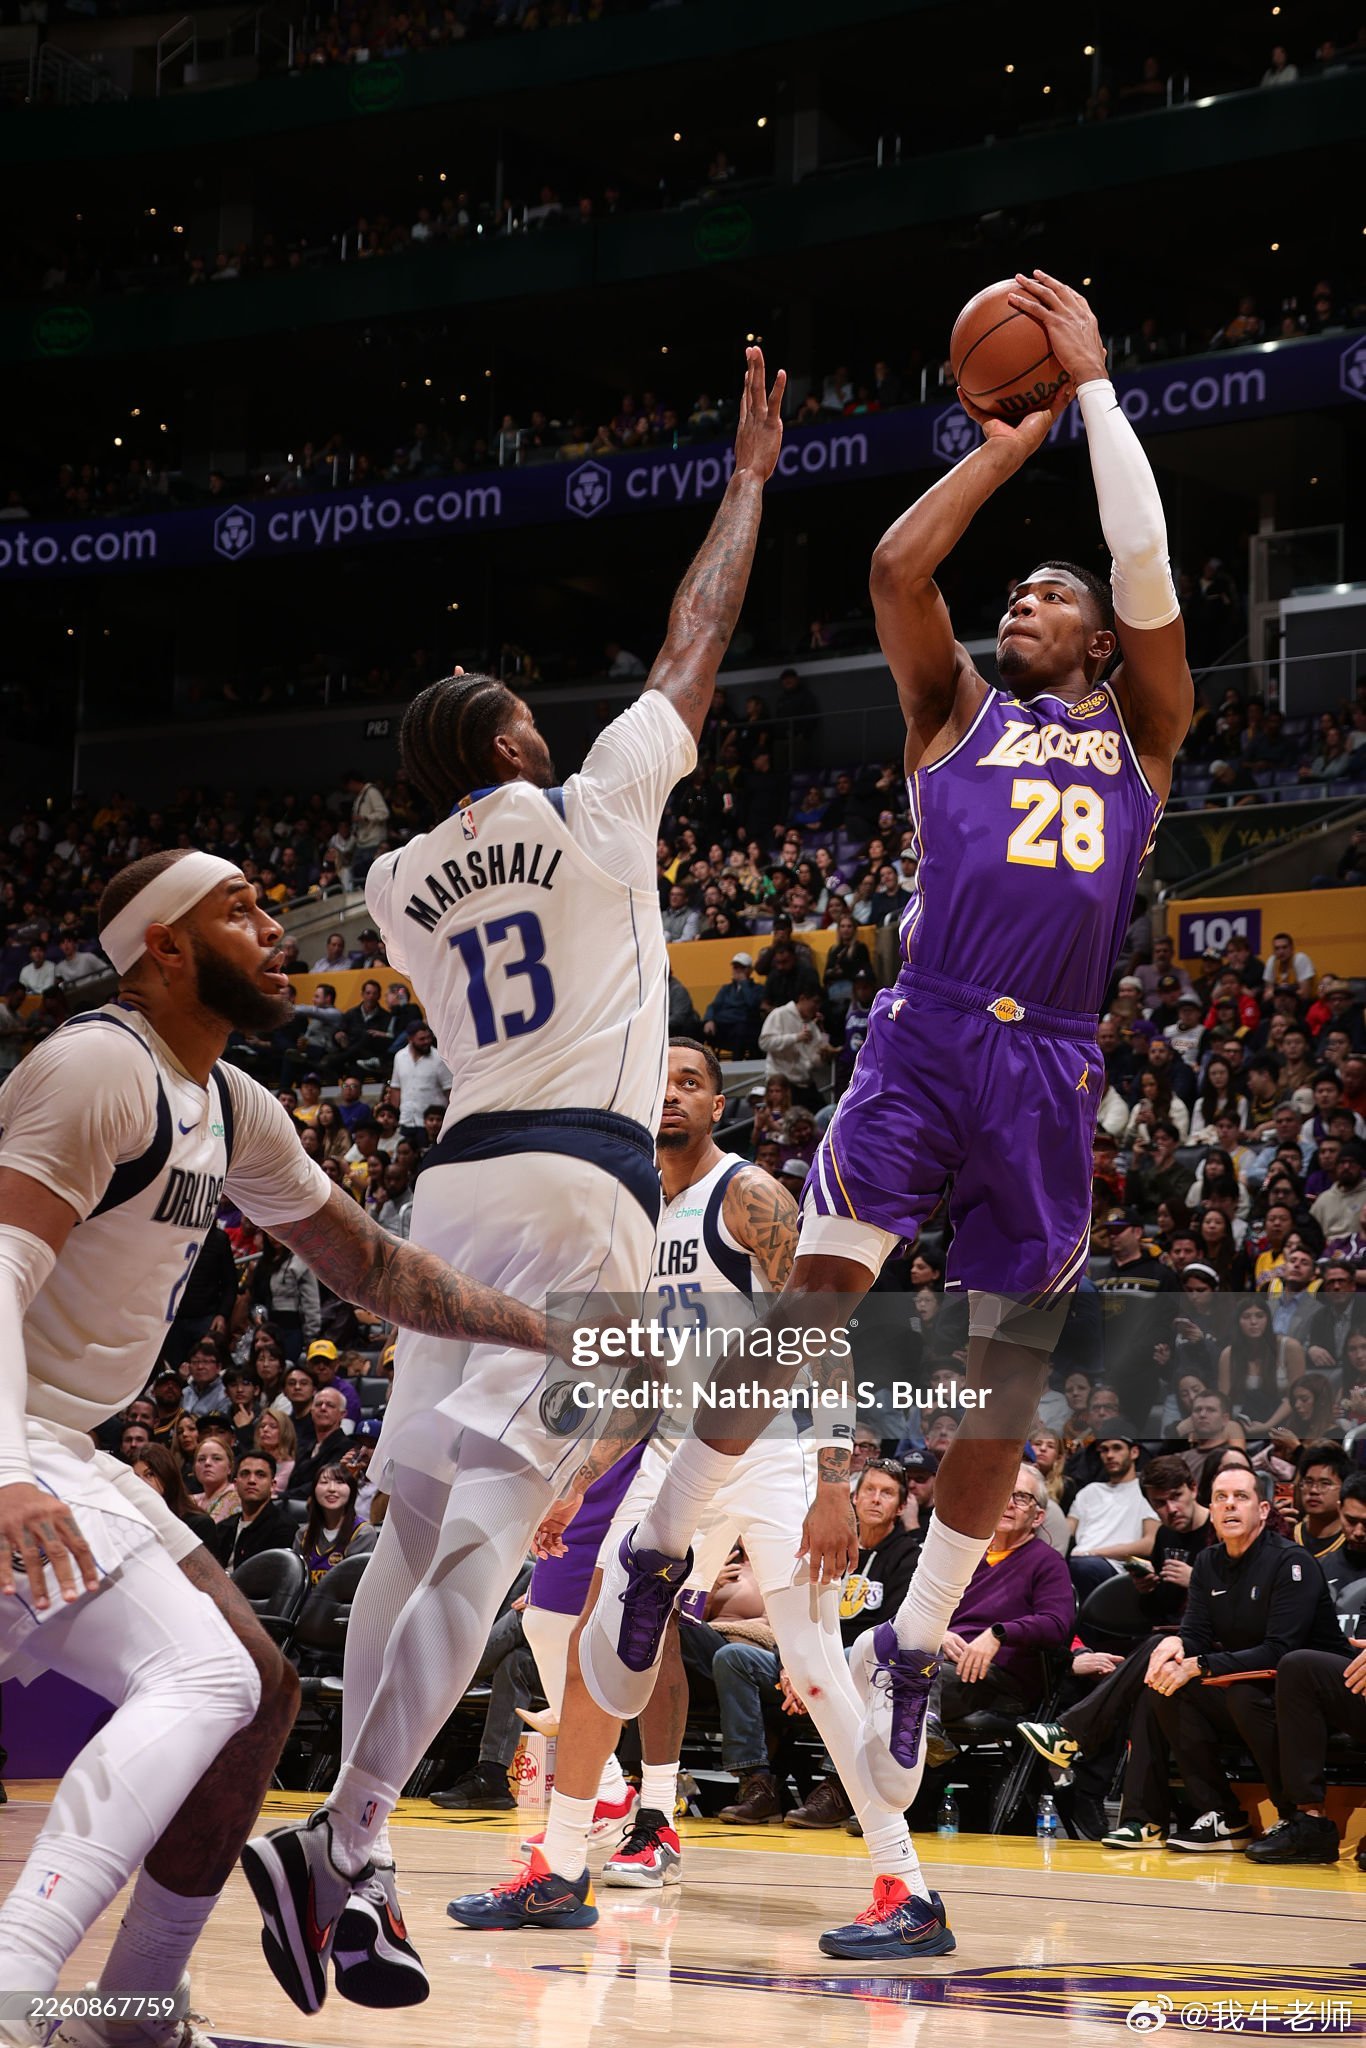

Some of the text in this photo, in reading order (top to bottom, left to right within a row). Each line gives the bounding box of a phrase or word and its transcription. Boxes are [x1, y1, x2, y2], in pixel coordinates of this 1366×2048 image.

[996, 370, 1072, 413] Wilso
[267, 484, 503, 545] crypto.com
[366, 719, 390, 737] PR3
[975, 719, 1123, 776] LAKERS
[1006, 778, 1105, 874] 28
[404, 842, 563, 934] MARSHALL
[1188, 916, 1248, 953] 101
[447, 910, 556, 1050] 13
[675, 1206, 704, 1219] chime
[653, 1238, 700, 1277] LAS
[657, 1282, 708, 1339] 25
[514, 1755, 532, 1769] POP
[516, 1766, 537, 1781] CORN
